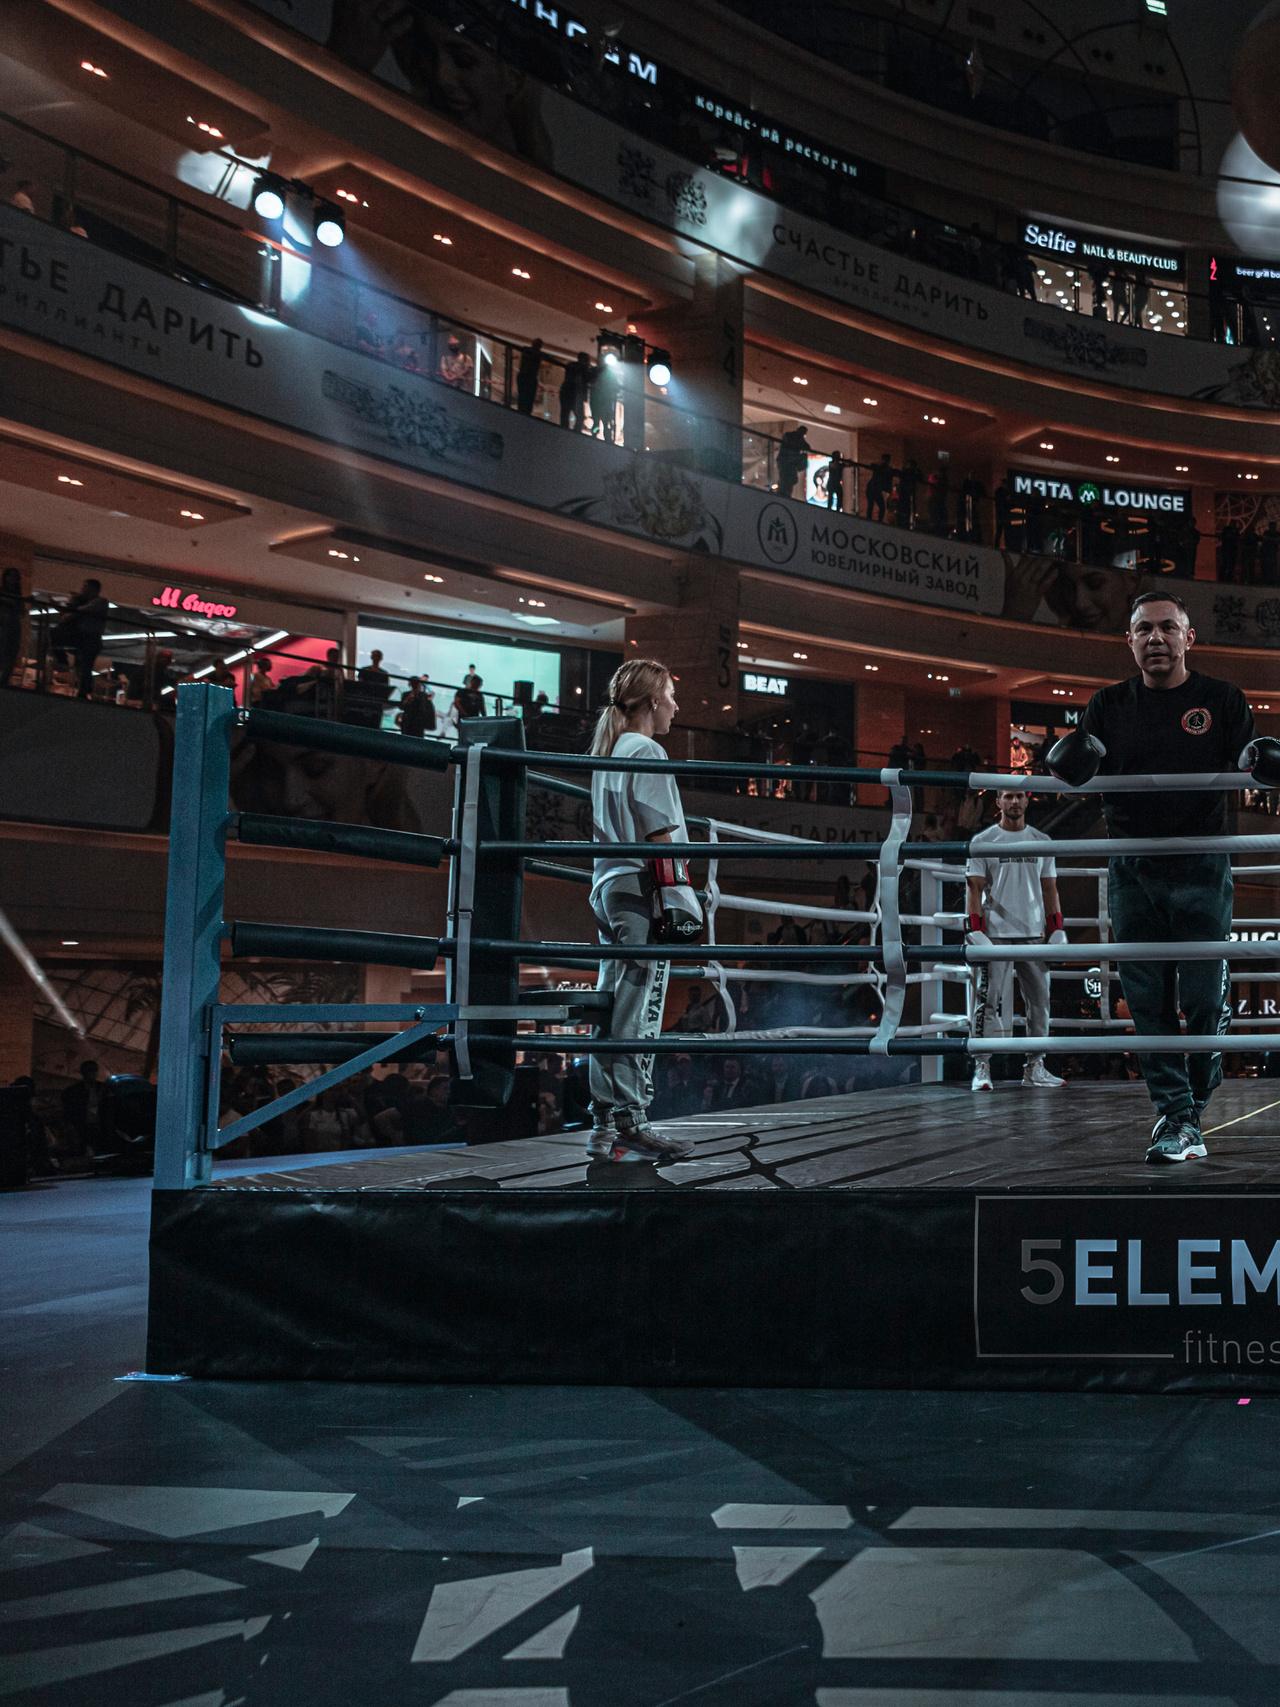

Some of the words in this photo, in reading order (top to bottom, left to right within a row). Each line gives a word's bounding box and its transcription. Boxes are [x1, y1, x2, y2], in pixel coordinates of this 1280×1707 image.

[772, 223, 879, 283] СЧАСТЬЕ
[894, 274, 989, 321] ДАРИТЬ
[1024, 223, 1077, 254] Selfie
[1082, 242, 1107, 259] NAIL
[1117, 249, 1153, 266] BEAUTY
[1153, 256, 1179, 271] CLUB
[1236, 266, 1254, 277] beer
[99, 282, 263, 369] ДАРИТЬ
[1103, 488, 1185, 512] LOUNGE
[811, 523, 980, 579] МОСКОВСКИЙ
[811, 549, 919, 587] ЮВЕЛИРНЫЙ
[925, 575, 979, 601] ЗАВОД
[744, 673, 788, 696] BEAT
